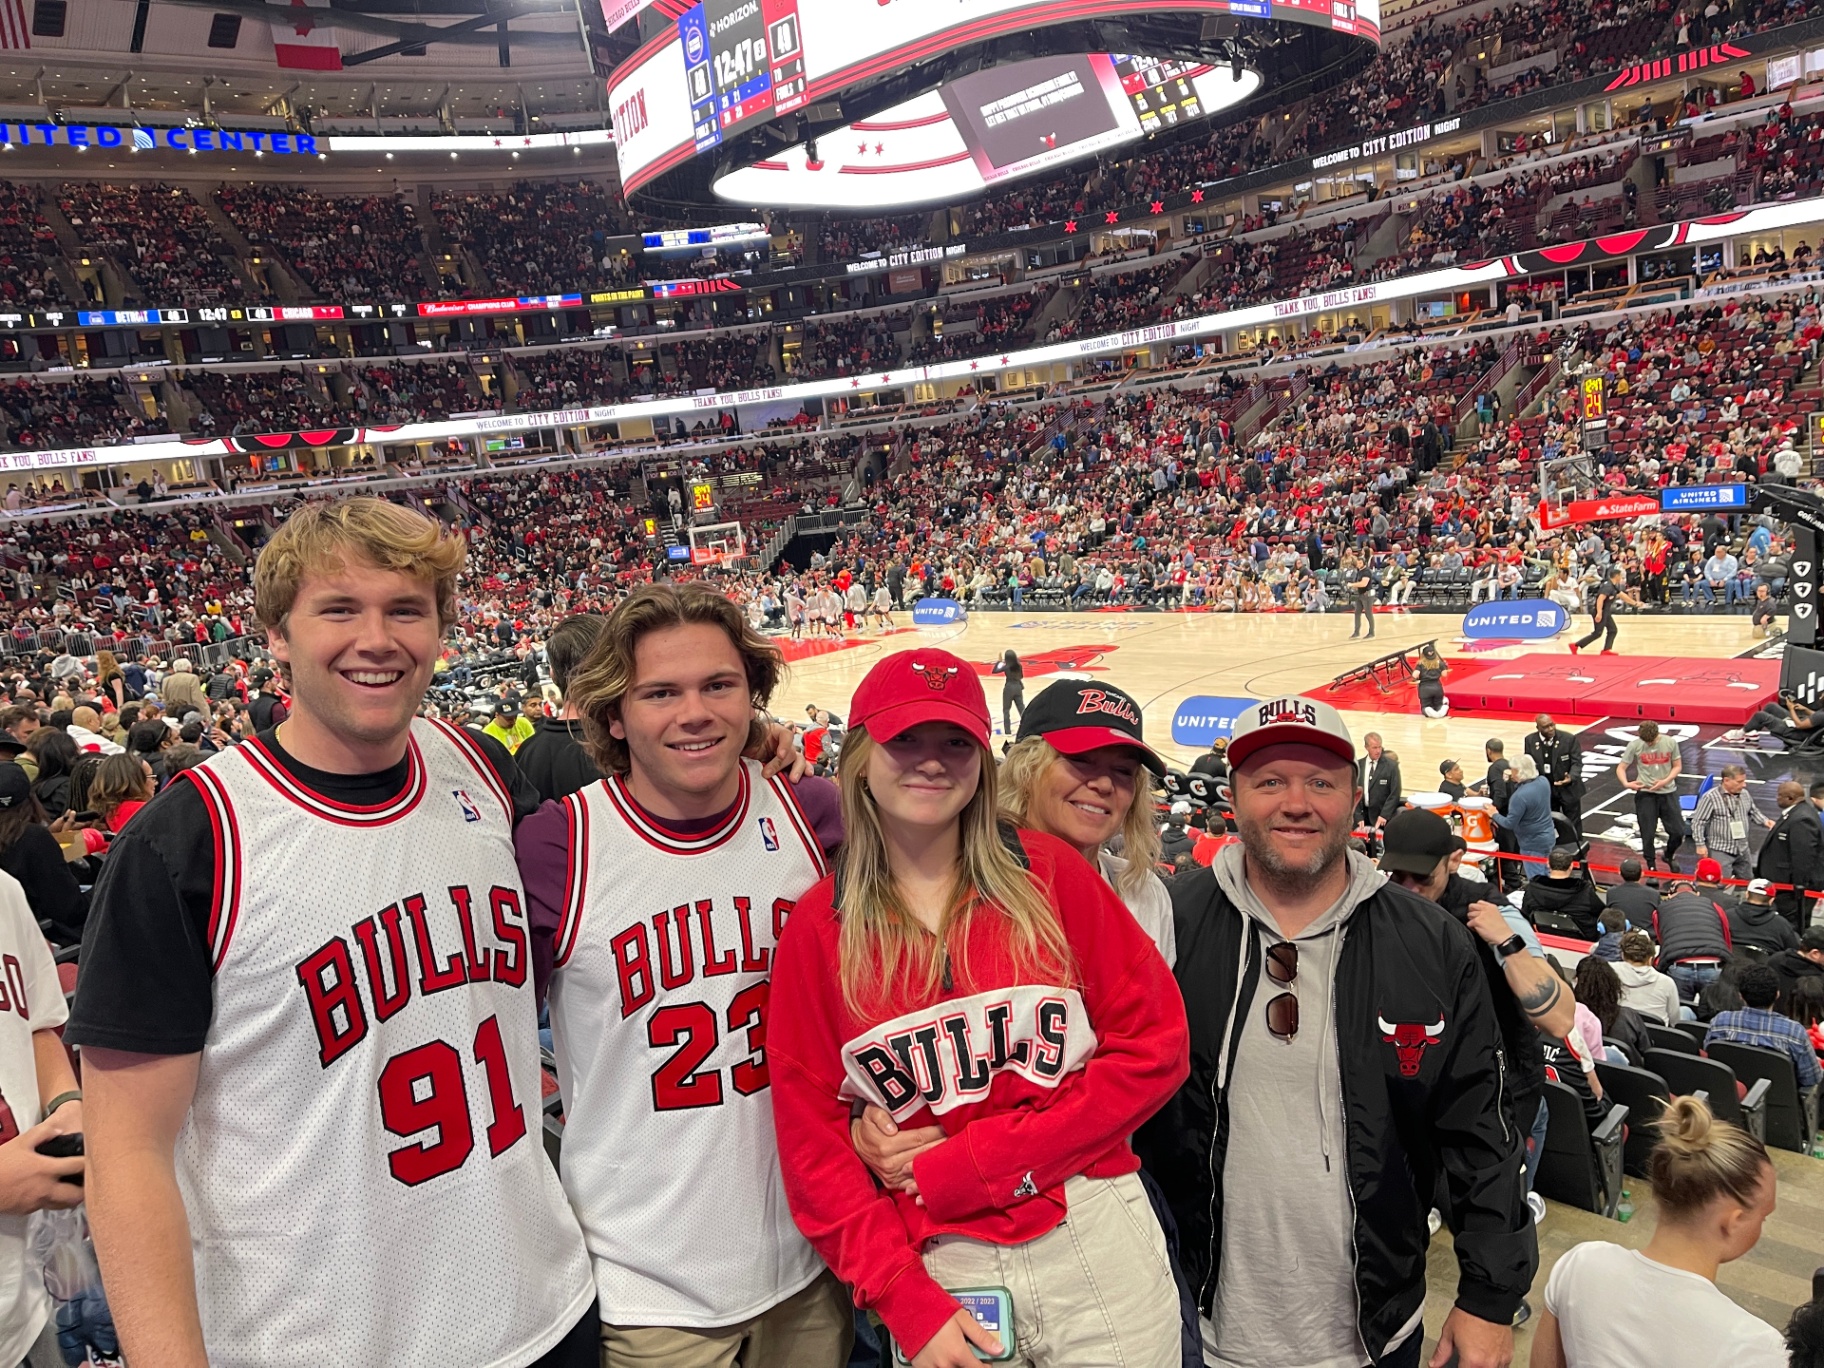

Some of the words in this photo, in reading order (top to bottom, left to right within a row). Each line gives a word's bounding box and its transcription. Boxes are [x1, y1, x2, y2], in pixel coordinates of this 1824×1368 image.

[714, 38, 753, 87] 12:47
[167, 127, 318, 155] CENTER
[1313, 150, 1348, 169] WELCOME
[1349, 147, 1360, 158] TO
[1362, 137, 1386, 157] CITY
[1389, 124, 1430, 149] EDITION
[1435, 118, 1461, 135] NIGHT
[846, 259, 878, 273] WELCOME
[878, 258, 887, 268] TO
[890, 253, 908, 267] CITY
[911, 246, 943, 263] EDITION
[946, 244, 966, 256] NIGHT
[590, 292, 611, 303] POINTS
[617, 290, 628, 300] THE
[628, 289, 645, 299] PAINT
[1273, 301, 1300, 316] THANK
[1323, 291, 1350, 307] BULLS
[1352, 286, 1377, 302] FANS!
[115, 311, 148, 323] DETROIT
[199, 307, 227, 320] 12:47
[282, 307, 313, 319] CHICAGO
[424, 303, 465, 314] Budweiser
[467, 302, 500, 311] CHAMPIONS
[501, 300, 516, 309] CLUB
[1080, 338, 1110, 351] WELCOME
[1111, 337, 1119, 346] TO
[1121, 330, 1140, 346] CITY
[1143, 324, 1176, 341] EDITION
[1180, 321, 1200, 333] NIGHT
[692, 396, 717, 408] THANK
[738, 390, 761, 403] BULLS
[1586, 394, 1602, 418] 24
[476, 418, 513, 430] WELCOME
[514, 417, 524, 426] TO
[527, 413, 549, 426] CITY
[553, 409, 590, 424] EDITION
[594, 408, 616, 418] NIGHT
[37, 451, 67, 465] BULLS
[71, 450, 98, 464] FANS!
[695, 494, 710, 507] 24
[1672, 497, 1717, 505] AIRLINES
[1680, 490, 1717, 498] UNITED
[1610, 503, 1633, 516] State
[1634, 501, 1657, 513] Farm
[1468, 614, 1533, 627] UNITED
[1076, 688, 1139, 725] Bulls
[1259, 699, 1316, 726] BULLS
[1640, 752, 1672, 764] BULLS
[1189, 779, 1208, 796] G
[1467, 815, 1478, 827] G
[295, 885, 528, 1069] BULLS
[648, 980, 771, 1112] 23
[851, 996, 1068, 1114] BULLS
[377, 1014, 527, 1187] 91
[960, 1297, 975, 1305] 2022
[980, 1297, 995, 1305] 2023
